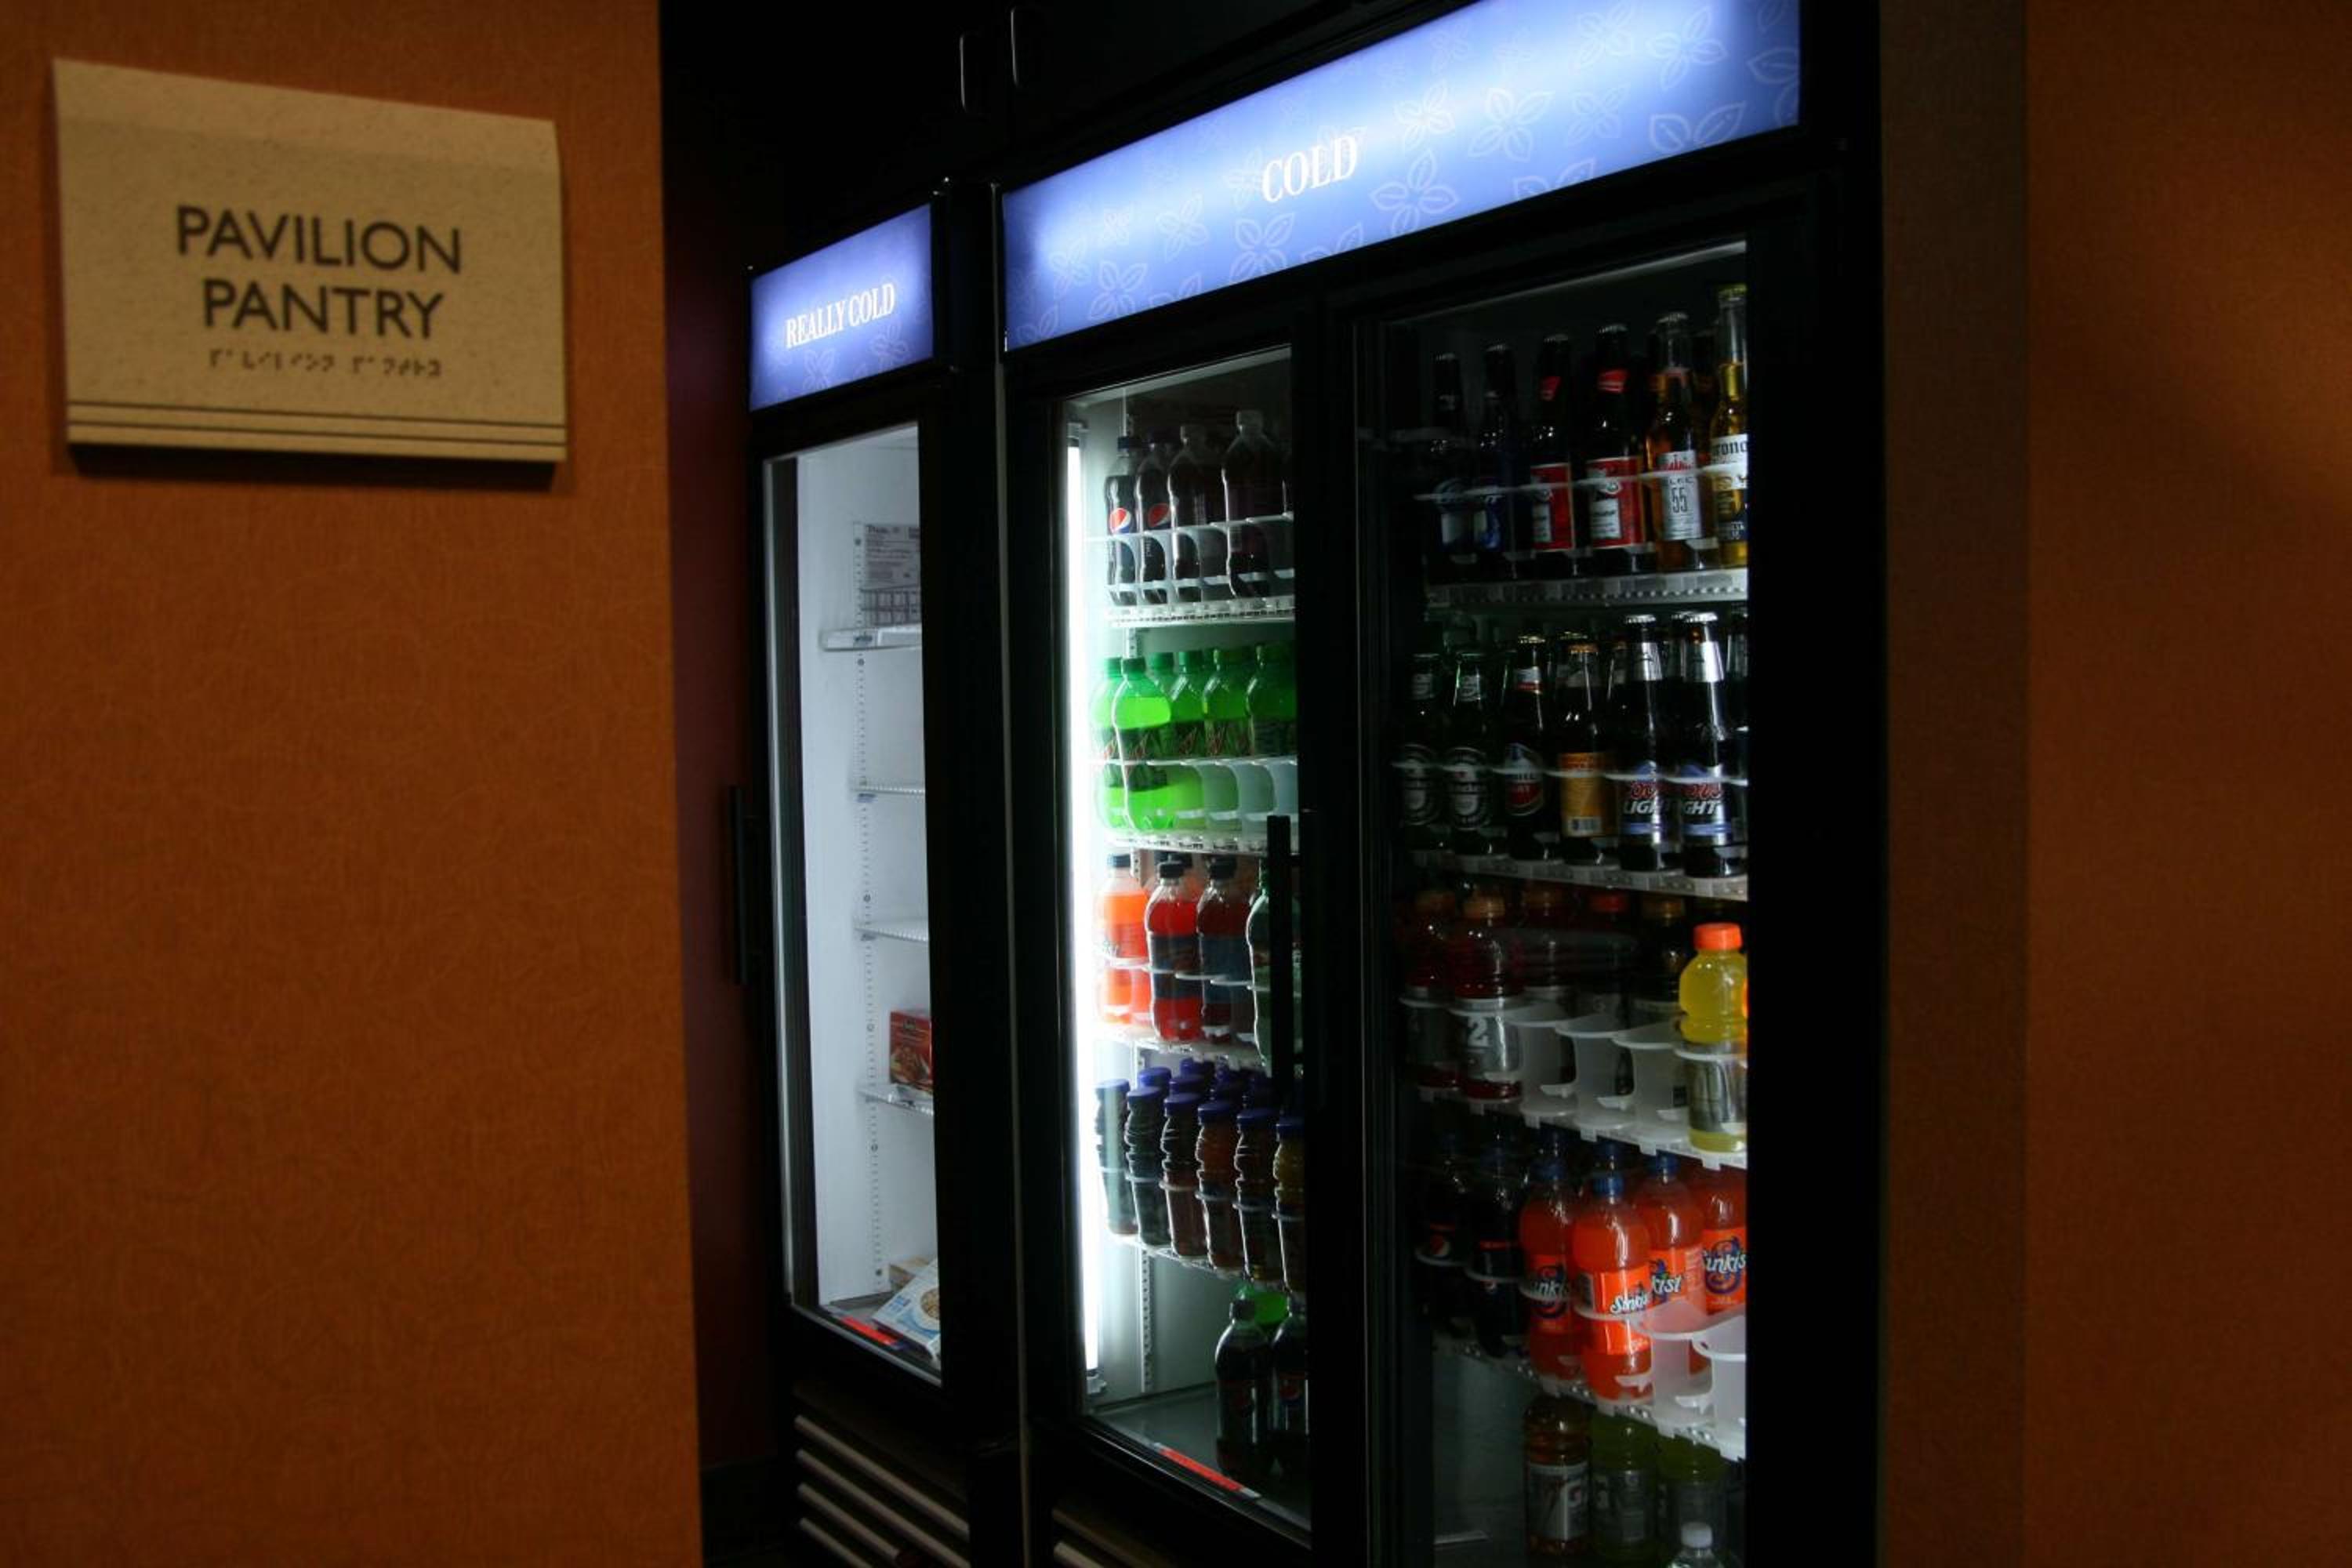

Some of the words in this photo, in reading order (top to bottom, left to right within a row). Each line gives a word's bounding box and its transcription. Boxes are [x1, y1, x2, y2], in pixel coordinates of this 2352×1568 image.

[1261, 135, 1358, 204] COLD
[176, 205, 462, 274] PAVILION
[202, 278, 445, 339] PANTRY
[786, 298, 848, 350] REALLY
[848, 282, 896, 327] COLD
[1671, 486, 1689, 514] 55
